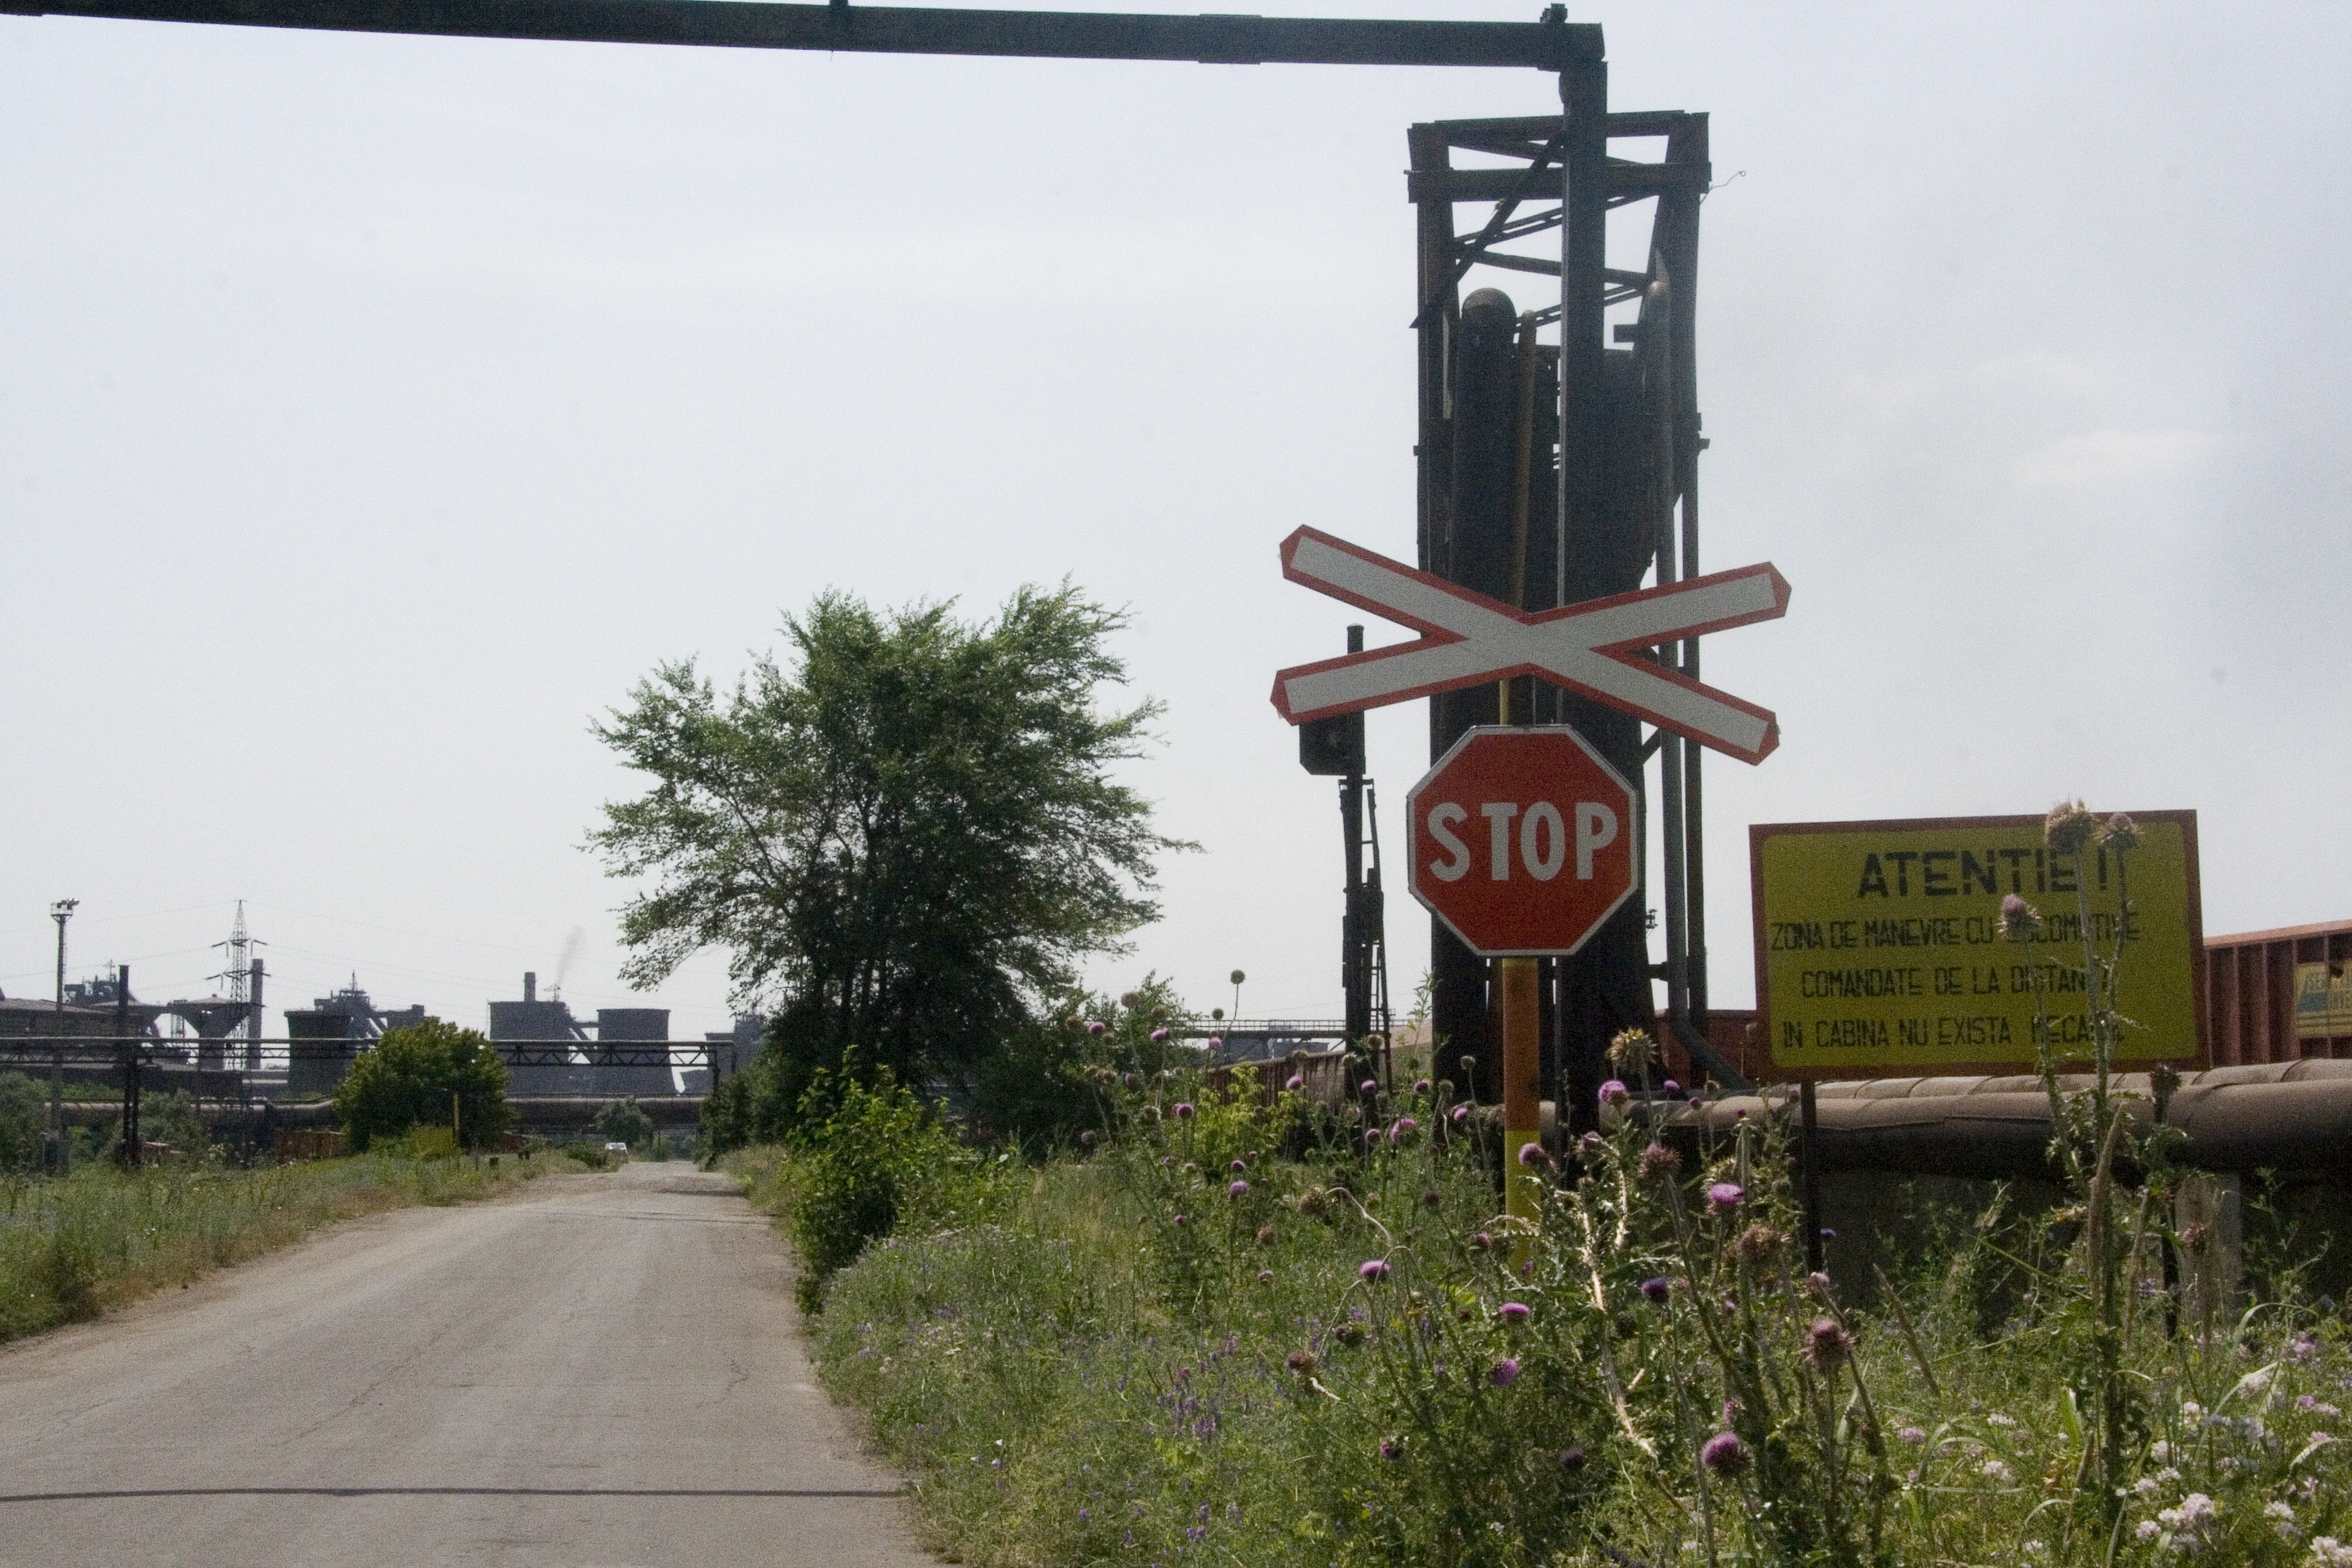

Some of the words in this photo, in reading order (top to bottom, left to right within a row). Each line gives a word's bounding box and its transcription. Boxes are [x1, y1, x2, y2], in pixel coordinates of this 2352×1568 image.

[1428, 801, 1618, 881] STOP
[1771, 921, 1825, 951] ZONA
[1829, 920, 1858, 949] DE
[1863, 918, 1961, 948] MANEVRE
[1965, 916, 1994, 945] CU
[1801, 967, 1923, 998] COMANDATE
[1934, 966, 1963, 995] DE
[1972, 966, 2002, 994] LA
[1782, 1021, 1803, 1048] IN
[1814, 1019, 1891, 1048] CABINA
[1897, 1018, 1929, 1047] NU
[1937, 1015, 2012, 1045] EXISTA
